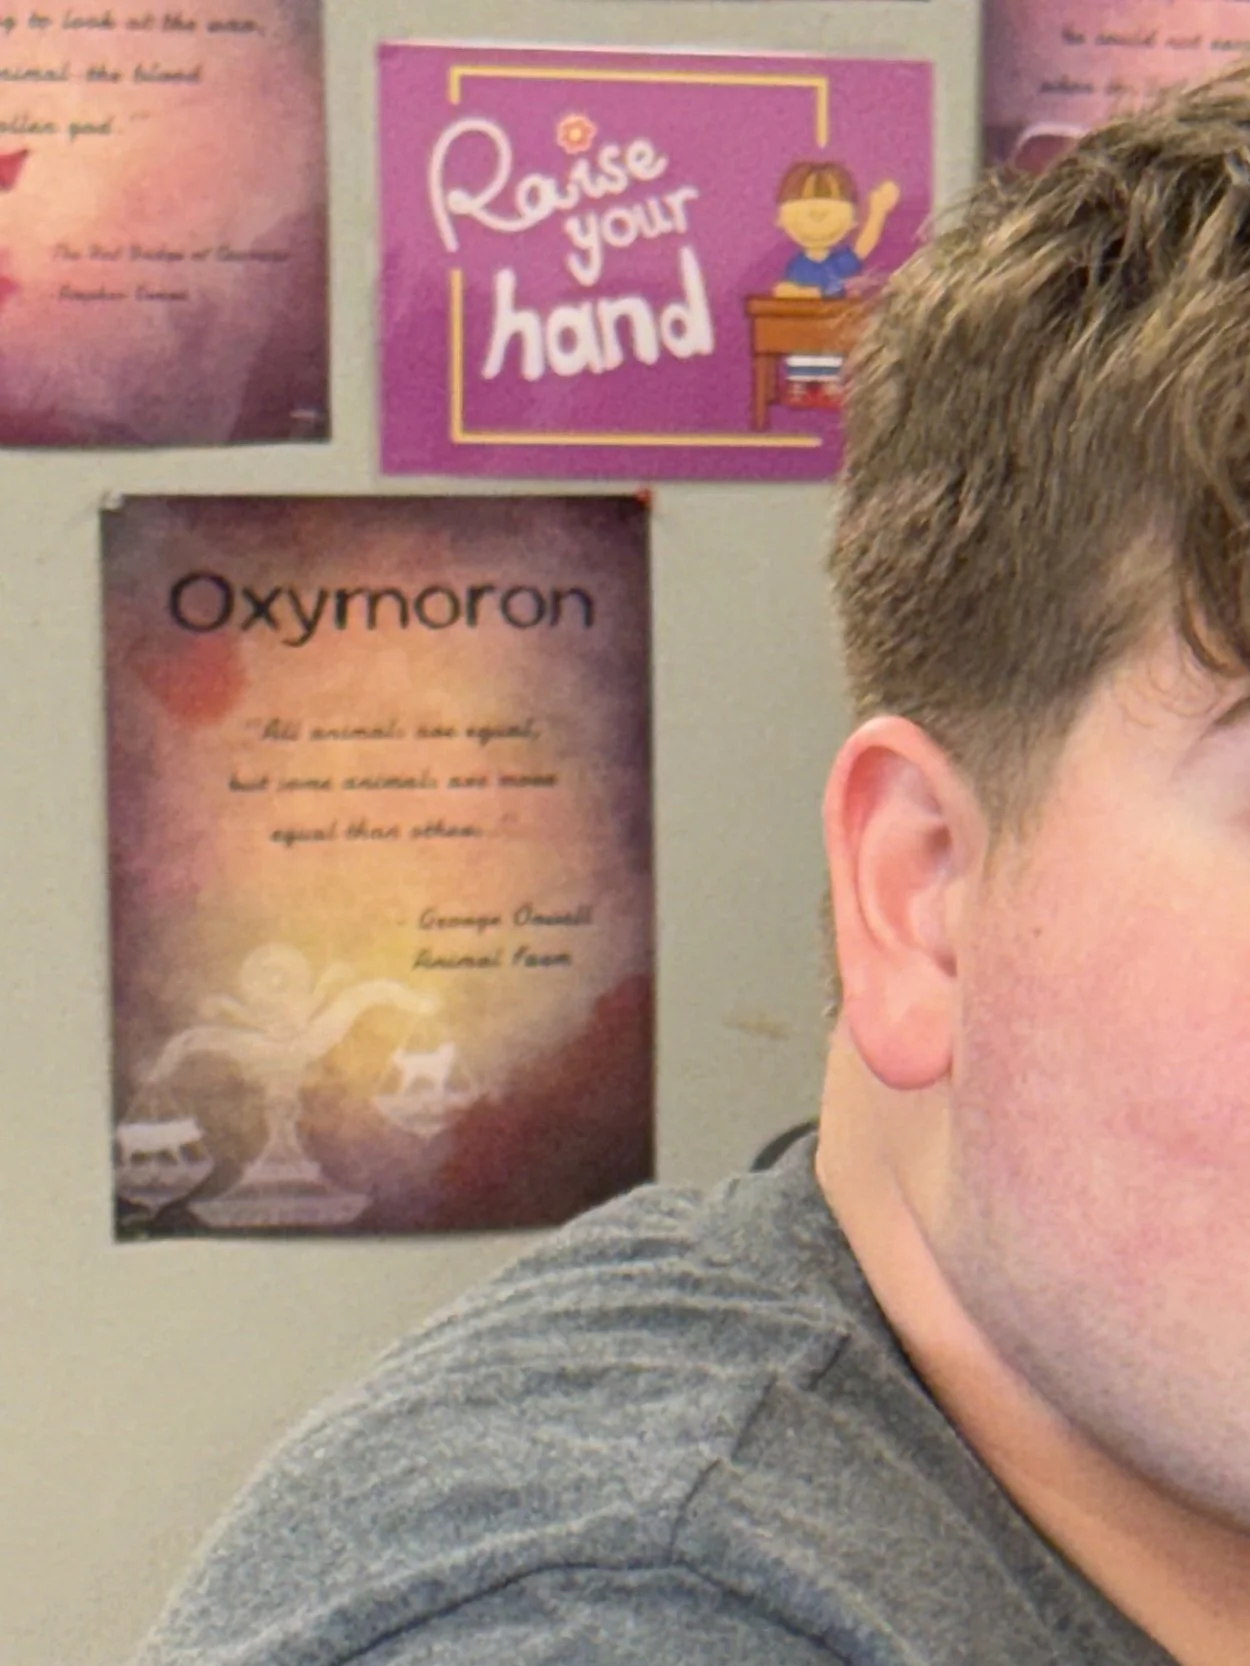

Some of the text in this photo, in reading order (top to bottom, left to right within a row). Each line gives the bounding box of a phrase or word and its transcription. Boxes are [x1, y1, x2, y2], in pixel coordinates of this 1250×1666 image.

[162, 11, 197, 32] the
[428, 117, 668, 253] Raise
[564, 186, 698, 287] your
[482, 246, 714, 381] hand
[169, 571, 595, 647] Oxymoron
[309, 718, 405, 741] animals
[414, 726, 457, 740] are
[229, 766, 558, 792] but some animals are more
[270, 818, 338, 848] equal
[345, 816, 402, 841] than
[417, 905, 502, 935] George
[512, 901, 594, 927] Orwell
[411, 945, 573, 971] Animal Farm
